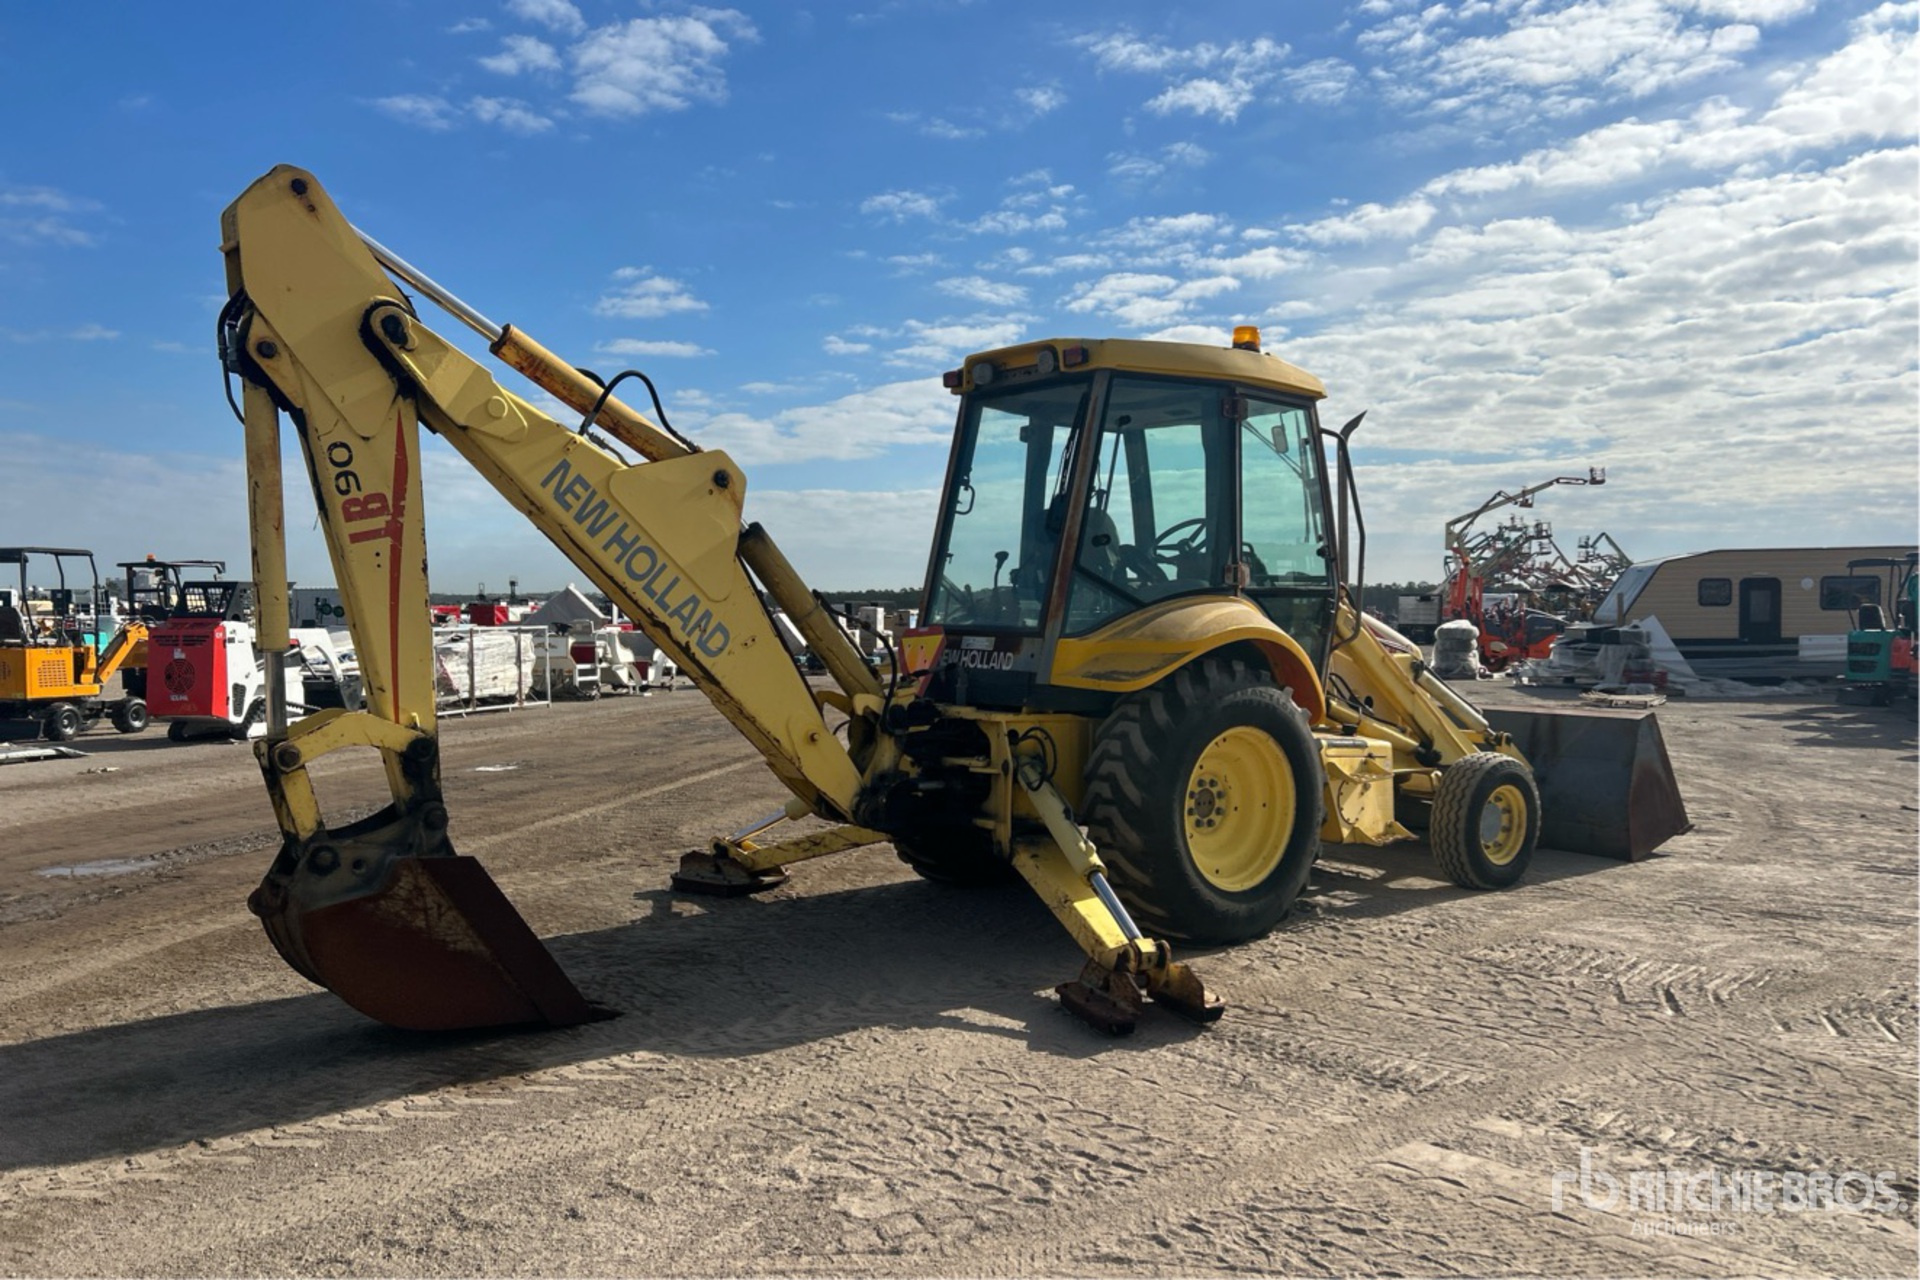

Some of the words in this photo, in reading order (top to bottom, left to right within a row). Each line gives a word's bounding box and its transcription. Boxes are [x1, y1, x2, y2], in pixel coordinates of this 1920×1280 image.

[541, 458, 610, 539] NEW
[604, 524, 730, 659] HOLLAND
[940, 648, 961, 667] EW
[960, 649, 1014, 671] HOLLAND
